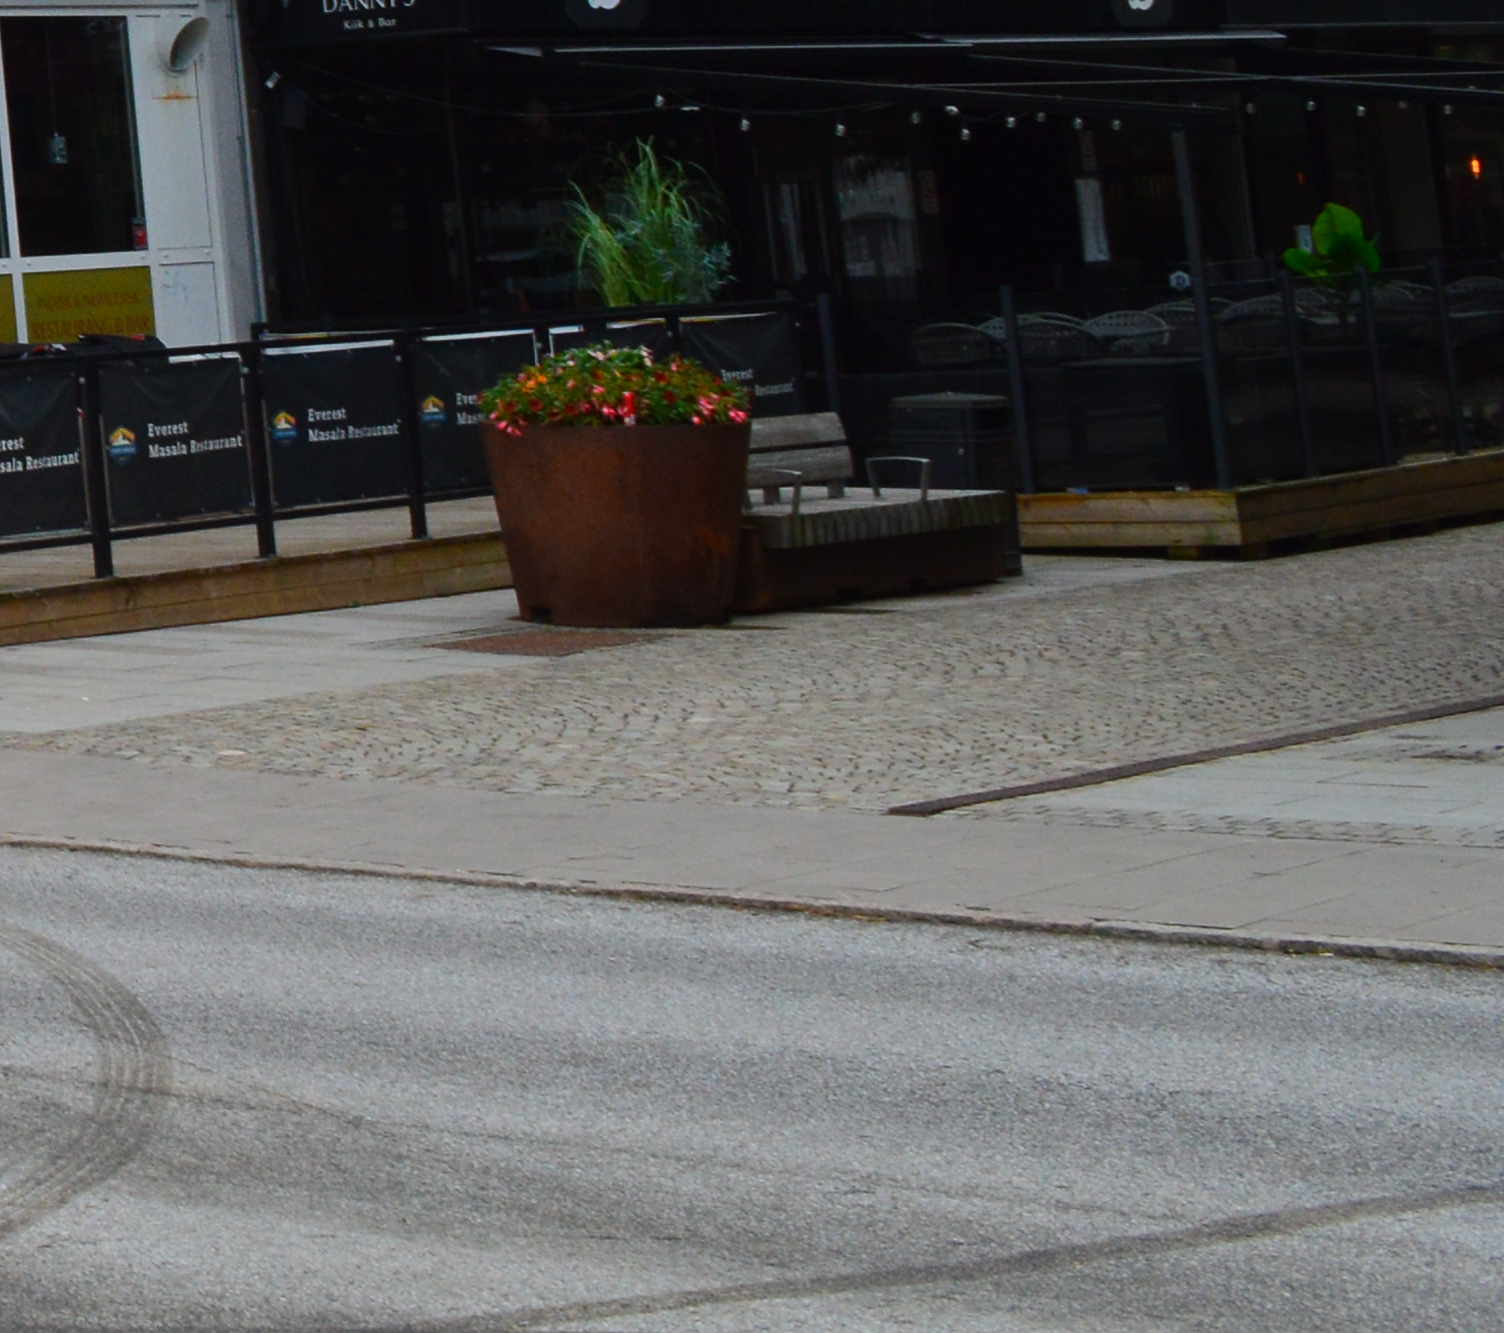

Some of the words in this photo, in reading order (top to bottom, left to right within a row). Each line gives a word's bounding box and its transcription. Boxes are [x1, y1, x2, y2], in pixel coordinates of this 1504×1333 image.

[307, 407, 347, 422] Everest
[147, 421, 189, 437] Everest
[308, 427, 346, 442] Masala
[148, 441, 187, 458] Masala
[190, 435, 243, 453] Restaurant
[26, 451, 80, 471] Restaurant
